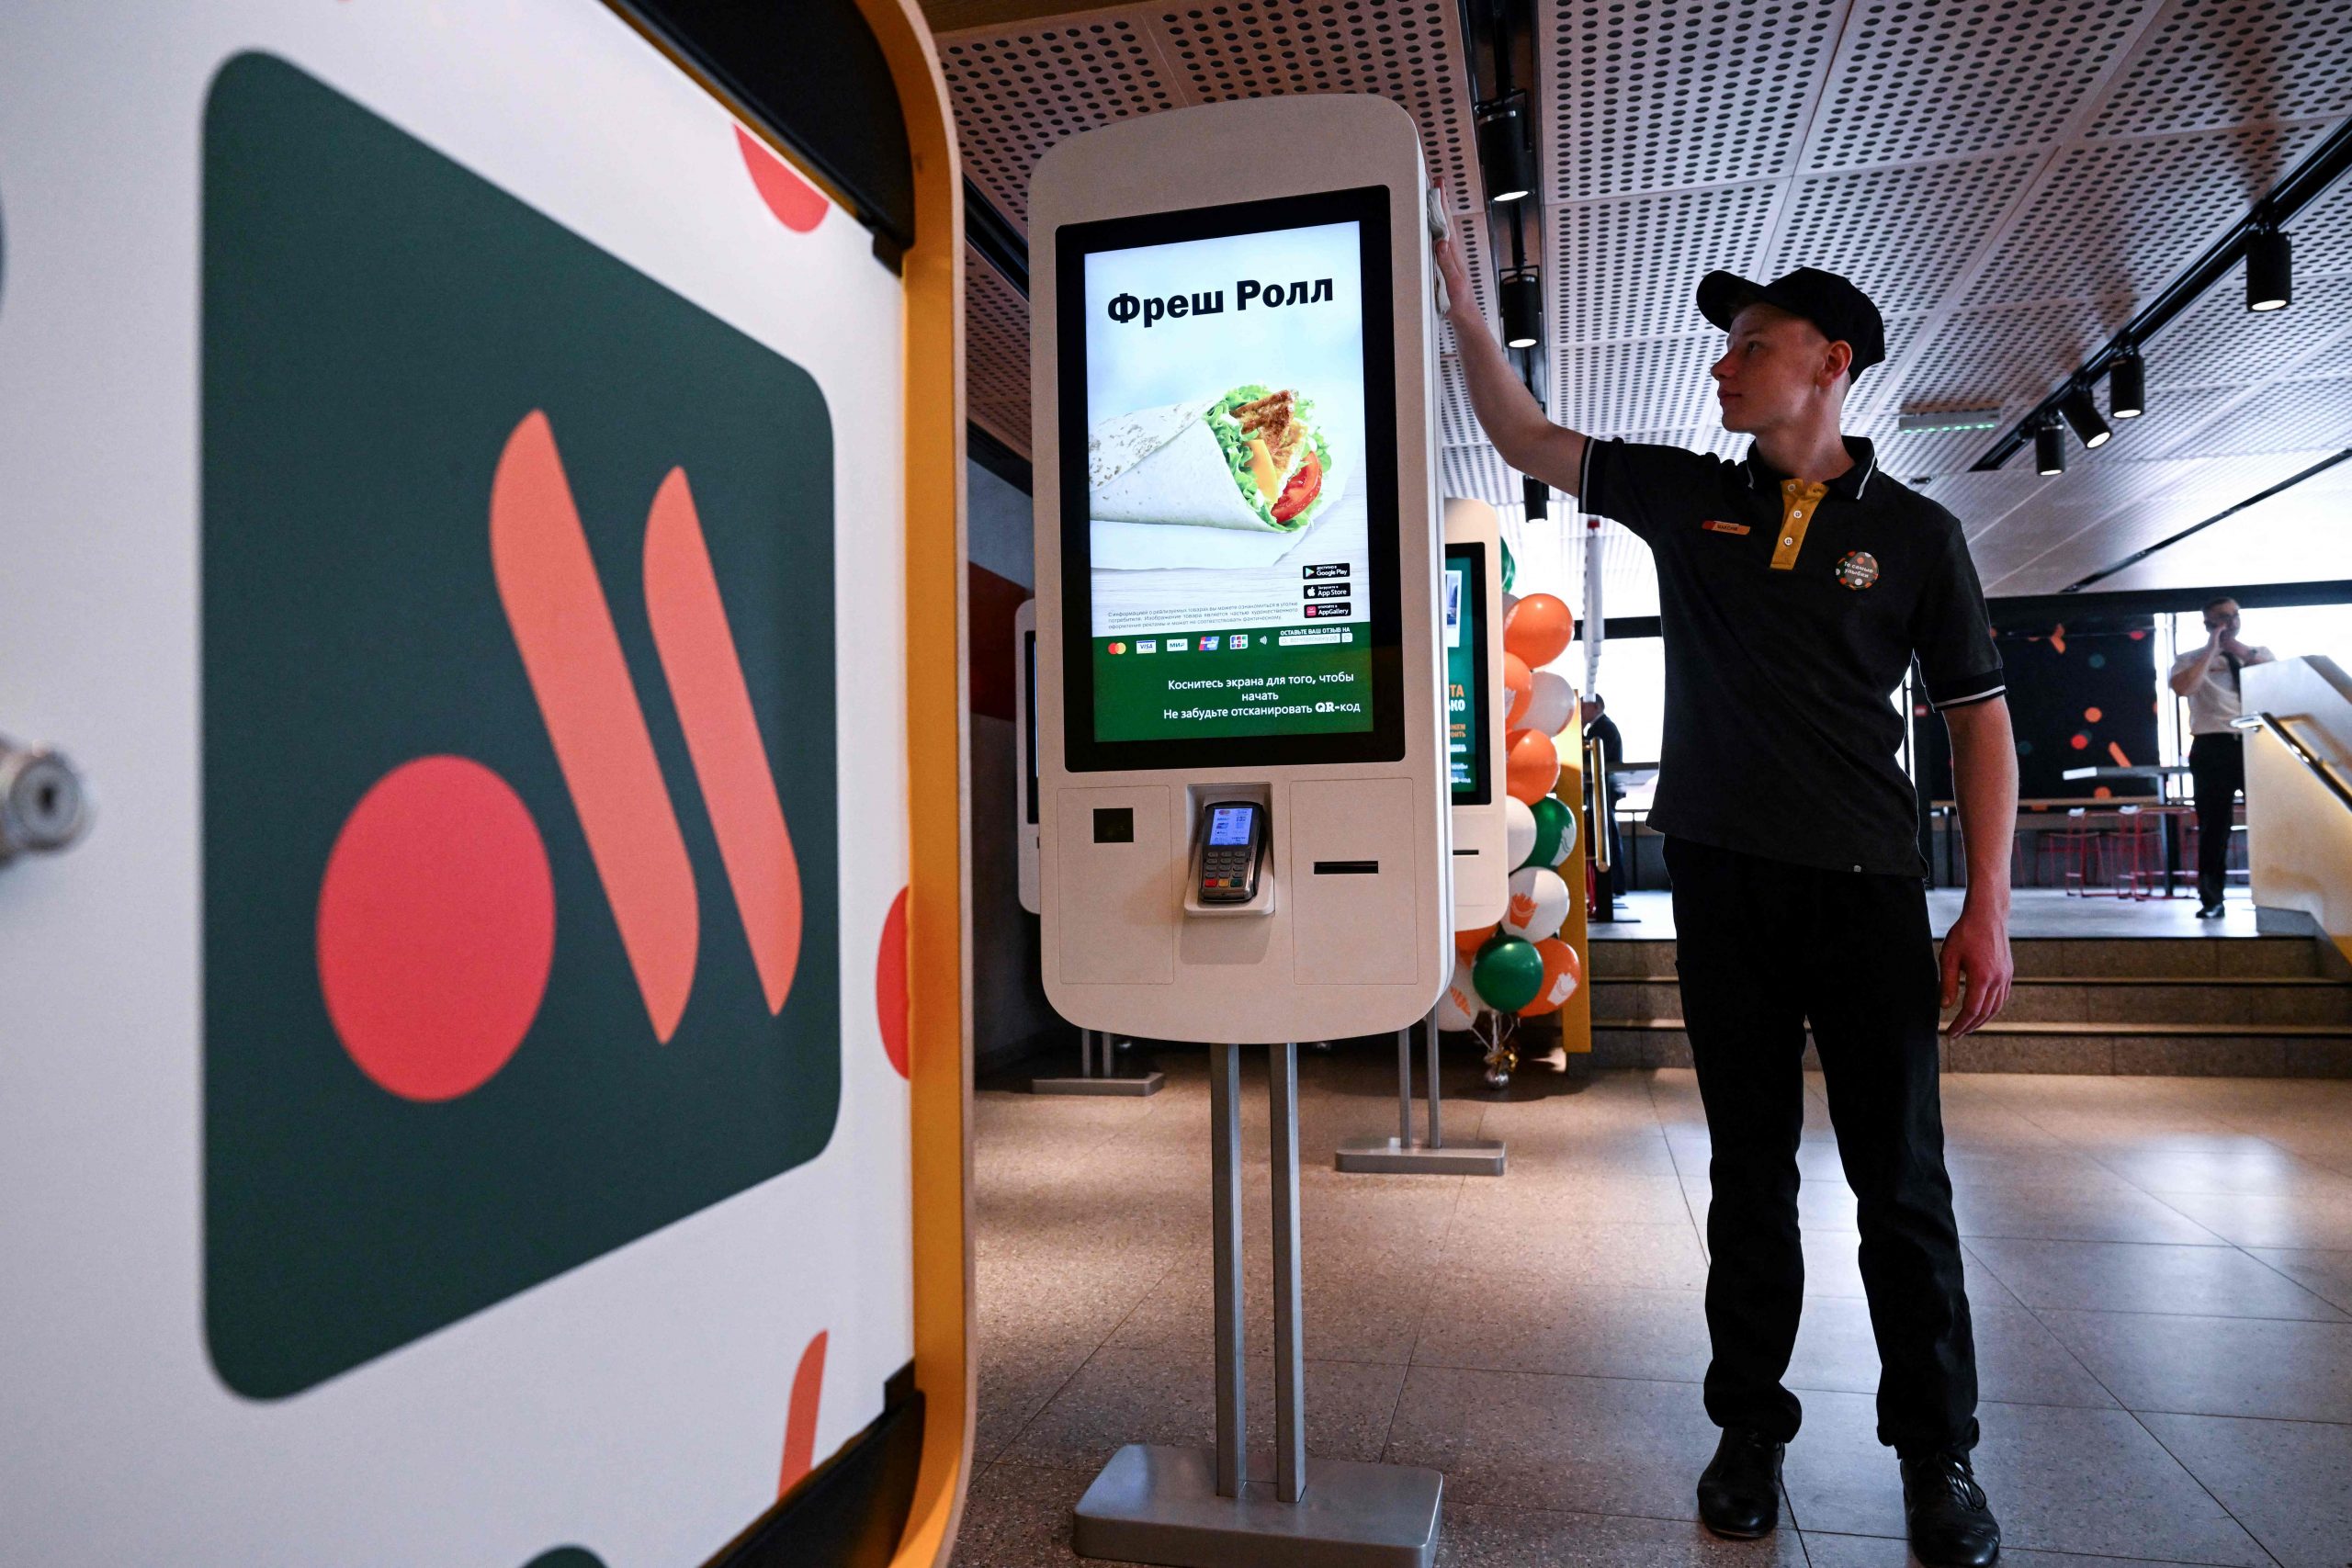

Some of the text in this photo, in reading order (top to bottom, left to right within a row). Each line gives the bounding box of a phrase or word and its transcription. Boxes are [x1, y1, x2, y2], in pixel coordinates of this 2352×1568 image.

[1107, 277, 1333, 328] Фреш Ролл
[1844, 569, 1869, 578] улыбки
[1851, 564, 1873, 573] самые
[1168, 671, 1354, 690] Коснитесь экрана для того, чтобы
[1241, 692, 1279, 702] начать
[1163, 702, 1361, 720] Не забудьте отсканировать QR-код
